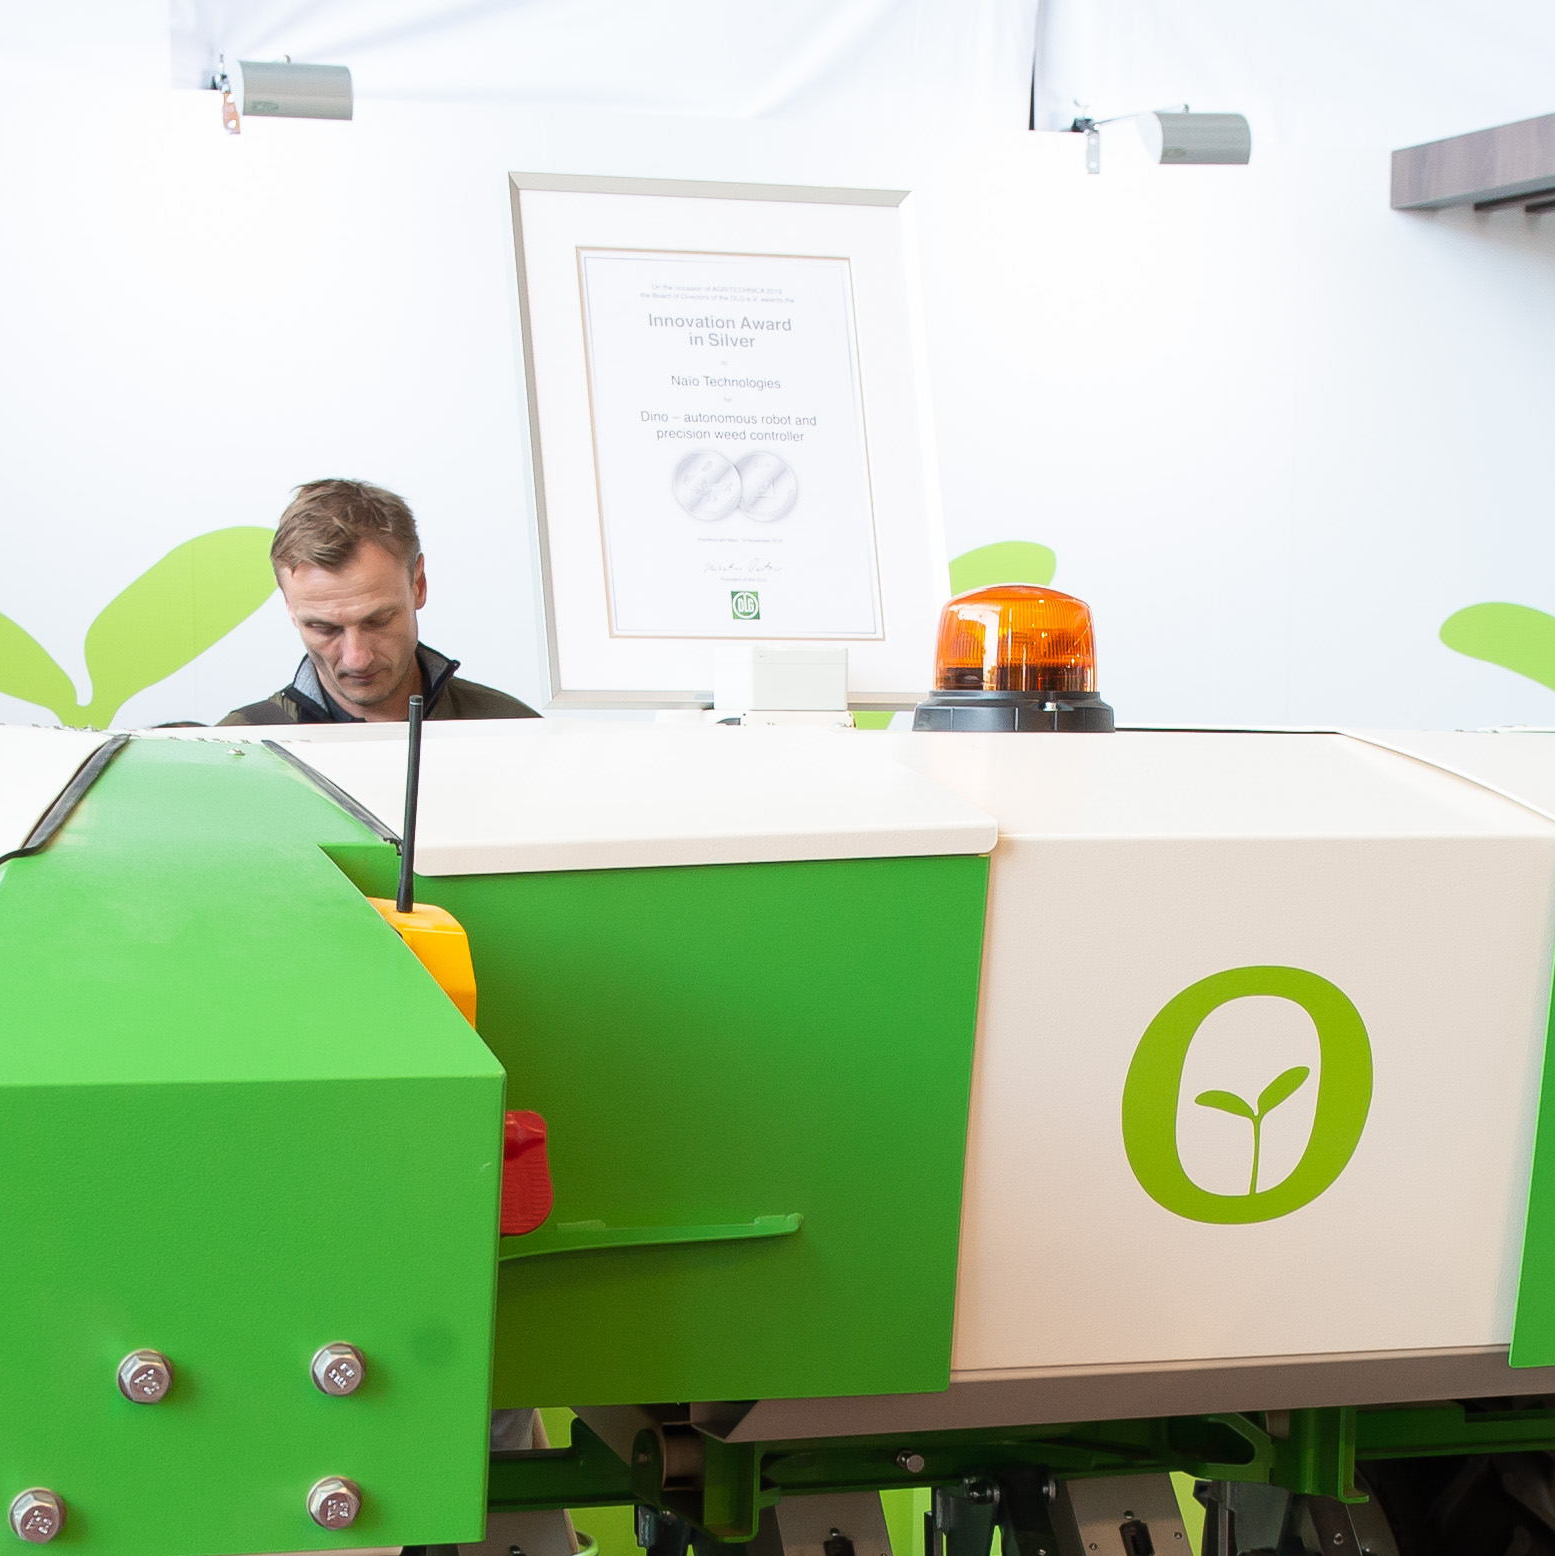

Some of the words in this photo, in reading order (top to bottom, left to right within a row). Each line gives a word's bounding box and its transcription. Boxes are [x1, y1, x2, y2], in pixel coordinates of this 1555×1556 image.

[648, 313, 735, 329] Innovation
[741, 316, 792, 331] Award
[689, 332, 704, 346] in
[709, 333, 755, 348] Silver
[703, 376, 781, 391] Technologies
[640, 410, 668, 422] Dino
[684, 413, 757, 424] autonomous
[761, 415, 791, 425] robot
[796, 416, 817, 426] and
[656, 429, 711, 440] precision
[714, 430, 746, 440] weed
[750, 431, 804, 441] controller
